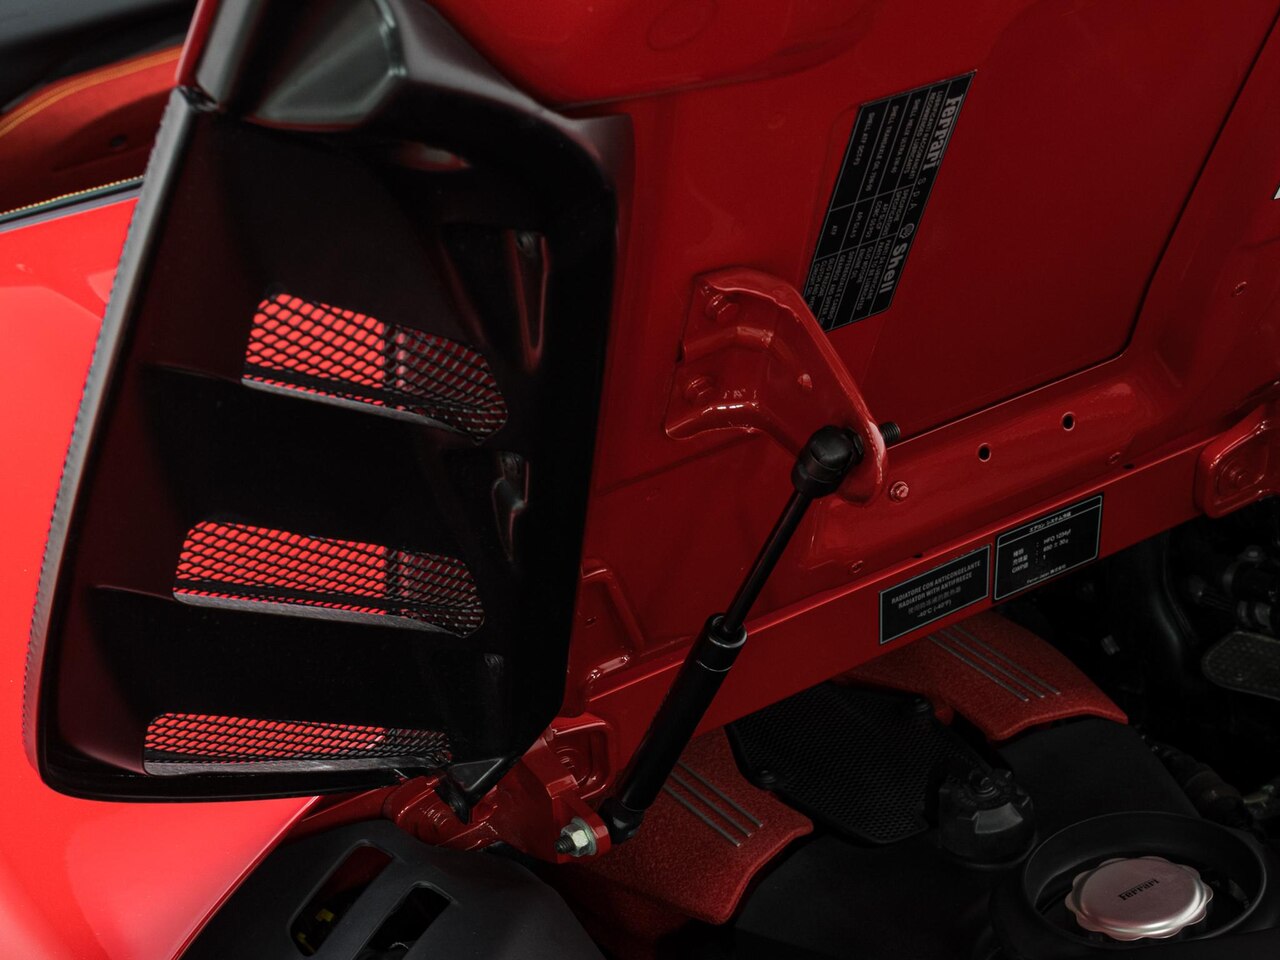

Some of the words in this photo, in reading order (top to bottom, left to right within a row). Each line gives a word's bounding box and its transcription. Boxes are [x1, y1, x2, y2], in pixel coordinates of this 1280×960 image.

[863, 111, 876, 132] SHELL
[887, 104, 900, 124] SHELL
[909, 98, 921, 118] SHELL
[915, 91, 936, 138] RECOMMENDED
[922, 94, 962, 170] Ferrari
[903, 137, 921, 175] LUBRICANTS
[879, 242, 907, 293] Shell
[891, 586, 921, 605] RADIATORE
[922, 580, 934, 591] CON
[934, 560, 981, 586] ANTICONGELANTE
[898, 592, 925, 609] RADIATOR
[926, 585, 940, 597] WITH
[941, 571, 972, 591] ANTIFREEZE
[1118, 879, 1160, 901] Ferrari
